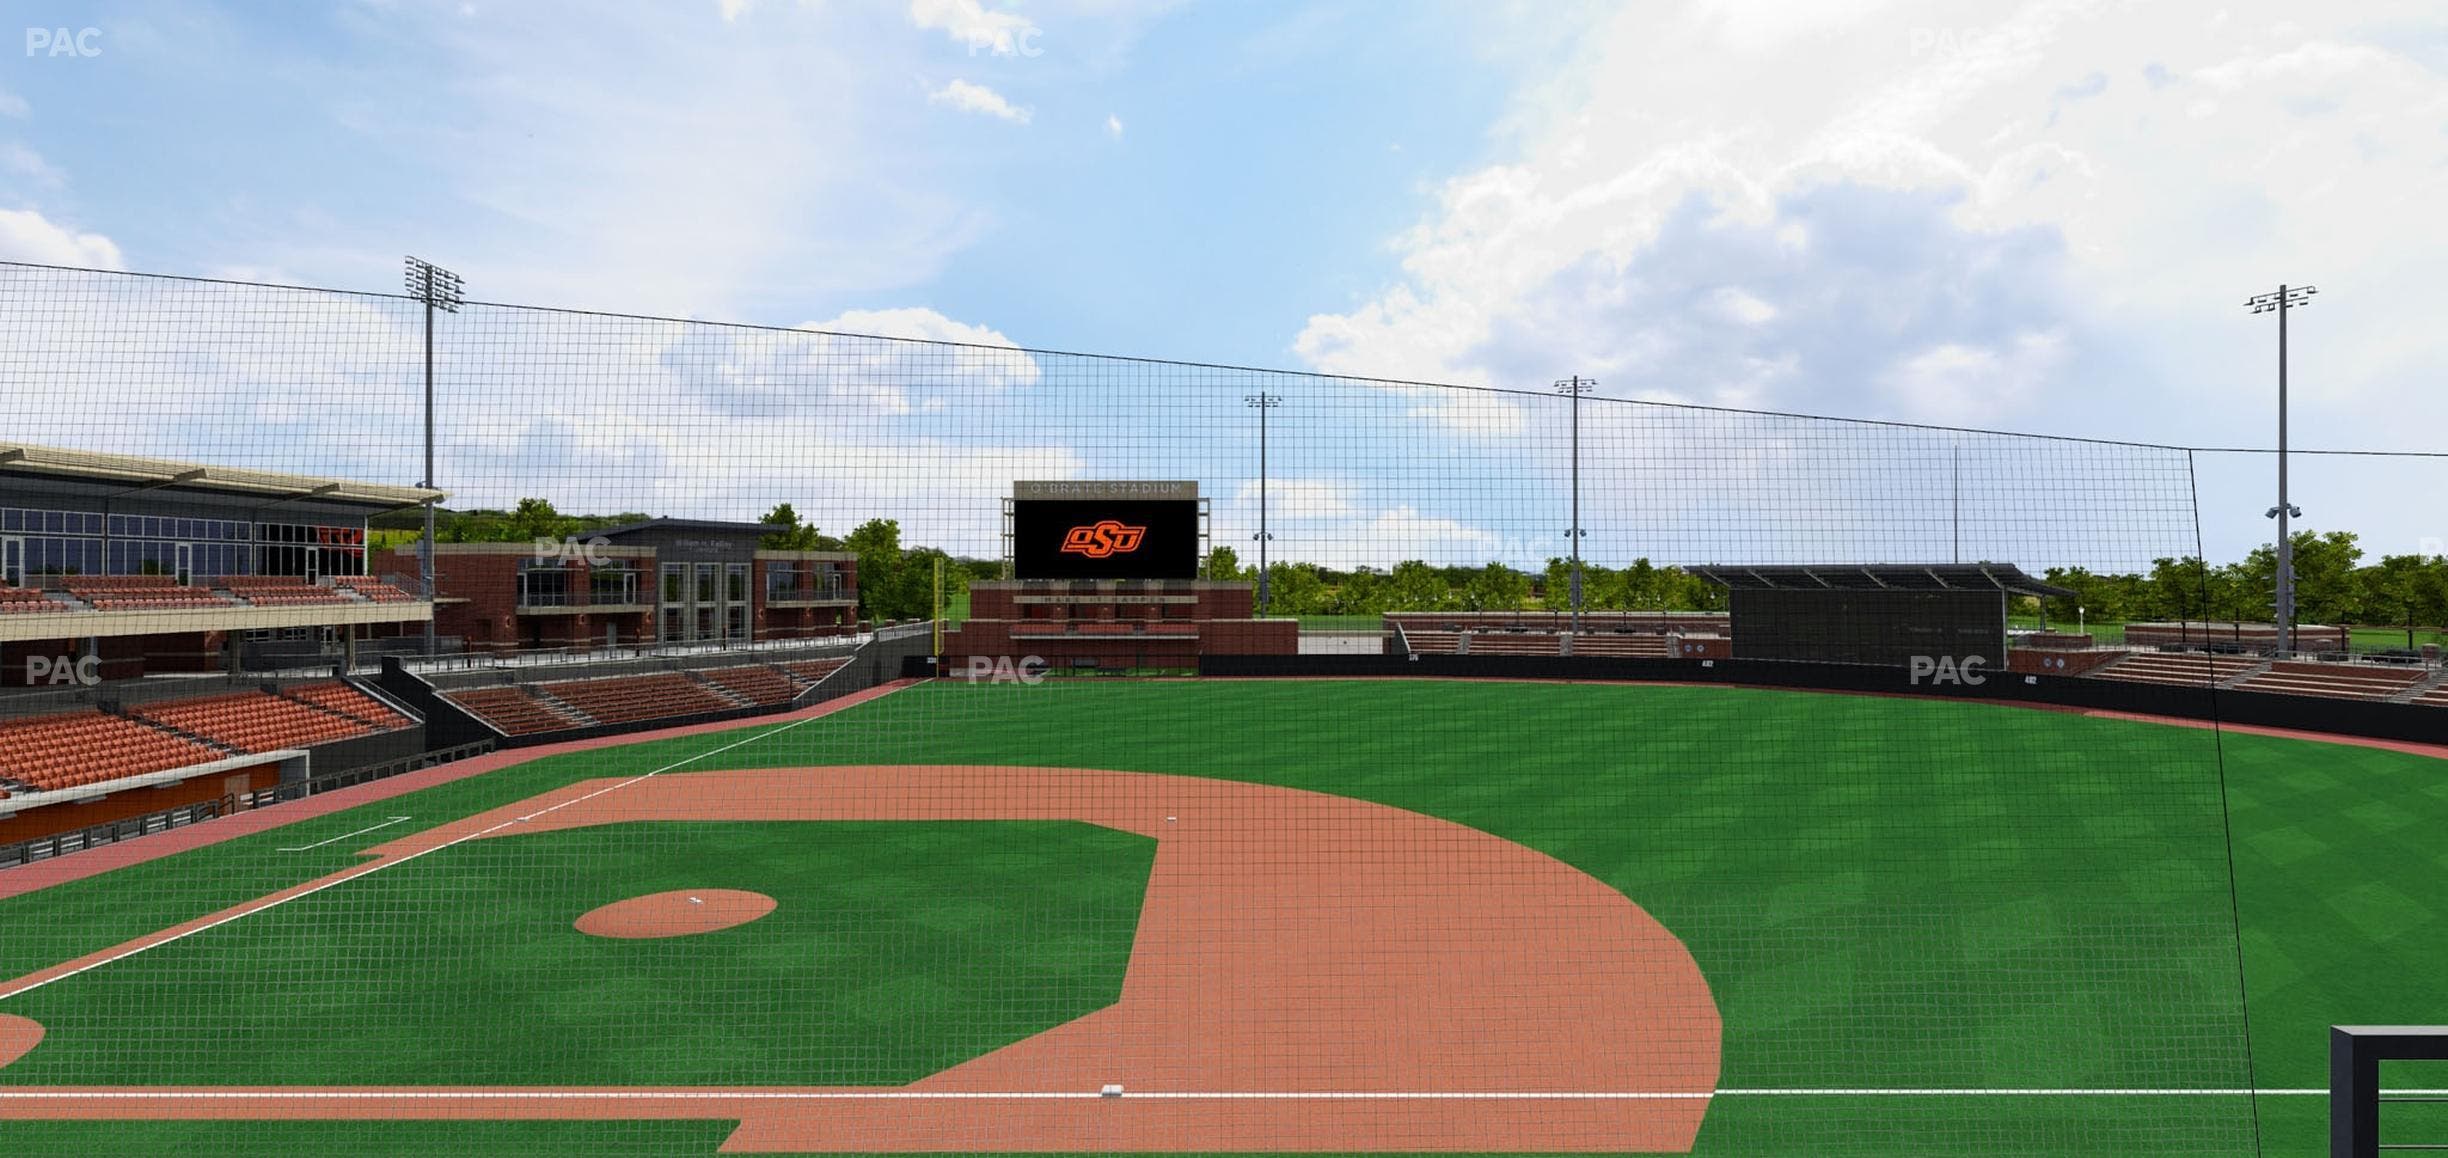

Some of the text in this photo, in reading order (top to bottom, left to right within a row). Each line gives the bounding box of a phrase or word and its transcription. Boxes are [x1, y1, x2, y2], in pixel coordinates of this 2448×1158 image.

[1030, 482, 1181, 494] O'BRATE STADIUM
[1060, 520, 1146, 558] OSU
